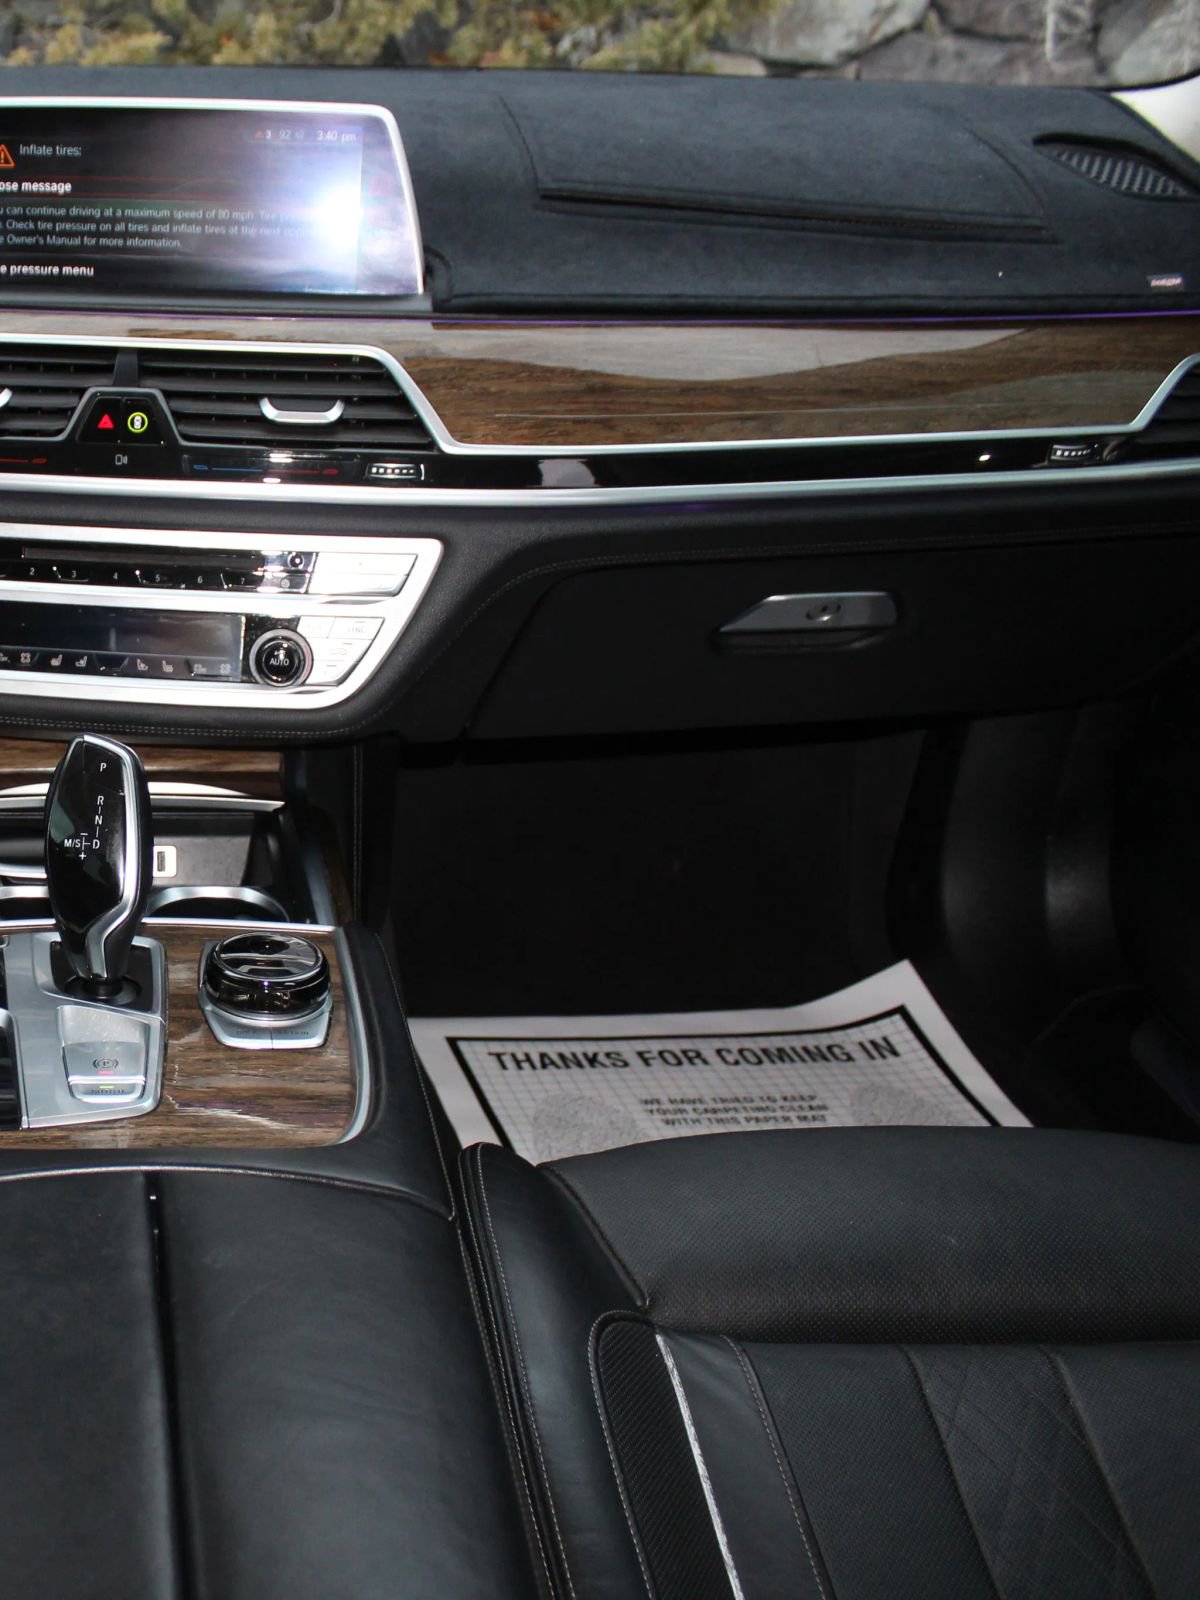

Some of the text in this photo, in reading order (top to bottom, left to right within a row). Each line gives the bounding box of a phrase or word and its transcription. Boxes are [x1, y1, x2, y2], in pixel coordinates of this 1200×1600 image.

[316, 130, 338, 140] 3:40
[19, 144, 82, 157] Inflate tires:
[21, 182, 72, 195] message
[6, 207, 23, 216] can
[26, 206, 66, 216] continue
[69, 206, 100, 218] driving
[104, 207, 113, 217] at
[124, 207, 170, 218] maximum
[173, 209, 203, 220] speed
[205, 209, 216, 219] of
[6, 219, 35, 230] Check
[38, 220, 53, 230] tire
[55, 222, 96, 232] pressure
[99, 222, 112, 231] on
[114, 221, 126, 231] all
[128, 222, 149, 232] tires
[152, 223, 170, 233] and
[172, 223, 202, 234] inflate
[205, 224, 226, 234] tires
[228, 225, 238, 235] at
[6, 233, 44, 245] Owner's
[46, 235, 81, 245] Manual
[83, 236, 96, 246] for
[99, 237, 123, 246] more
[9, 264, 60, 277] pressure
[62, 266, 94, 276] menu
[29, 567, 35, 576] 2
[71, 570, 77, 579] 3
[112, 572, 118, 580] 4
[155, 574, 161, 582] 5
[197, 575, 203, 584] 6
[240, 577, 246, 585] 7
[269, 657, 290, 666] AUTO
[100, 762, 107, 772] P
[97, 795, 104, 806] R
[94, 814, 103, 825] N
[63, 838, 100, 849] M/S D
[487, 1035, 901, 1072] THANKS FOR COMING IN
[644, 1104, 829, 1116] YOUR CARPETING CLEAN
[661, 1114, 827, 1126] WITH THIS PAPER MAT
